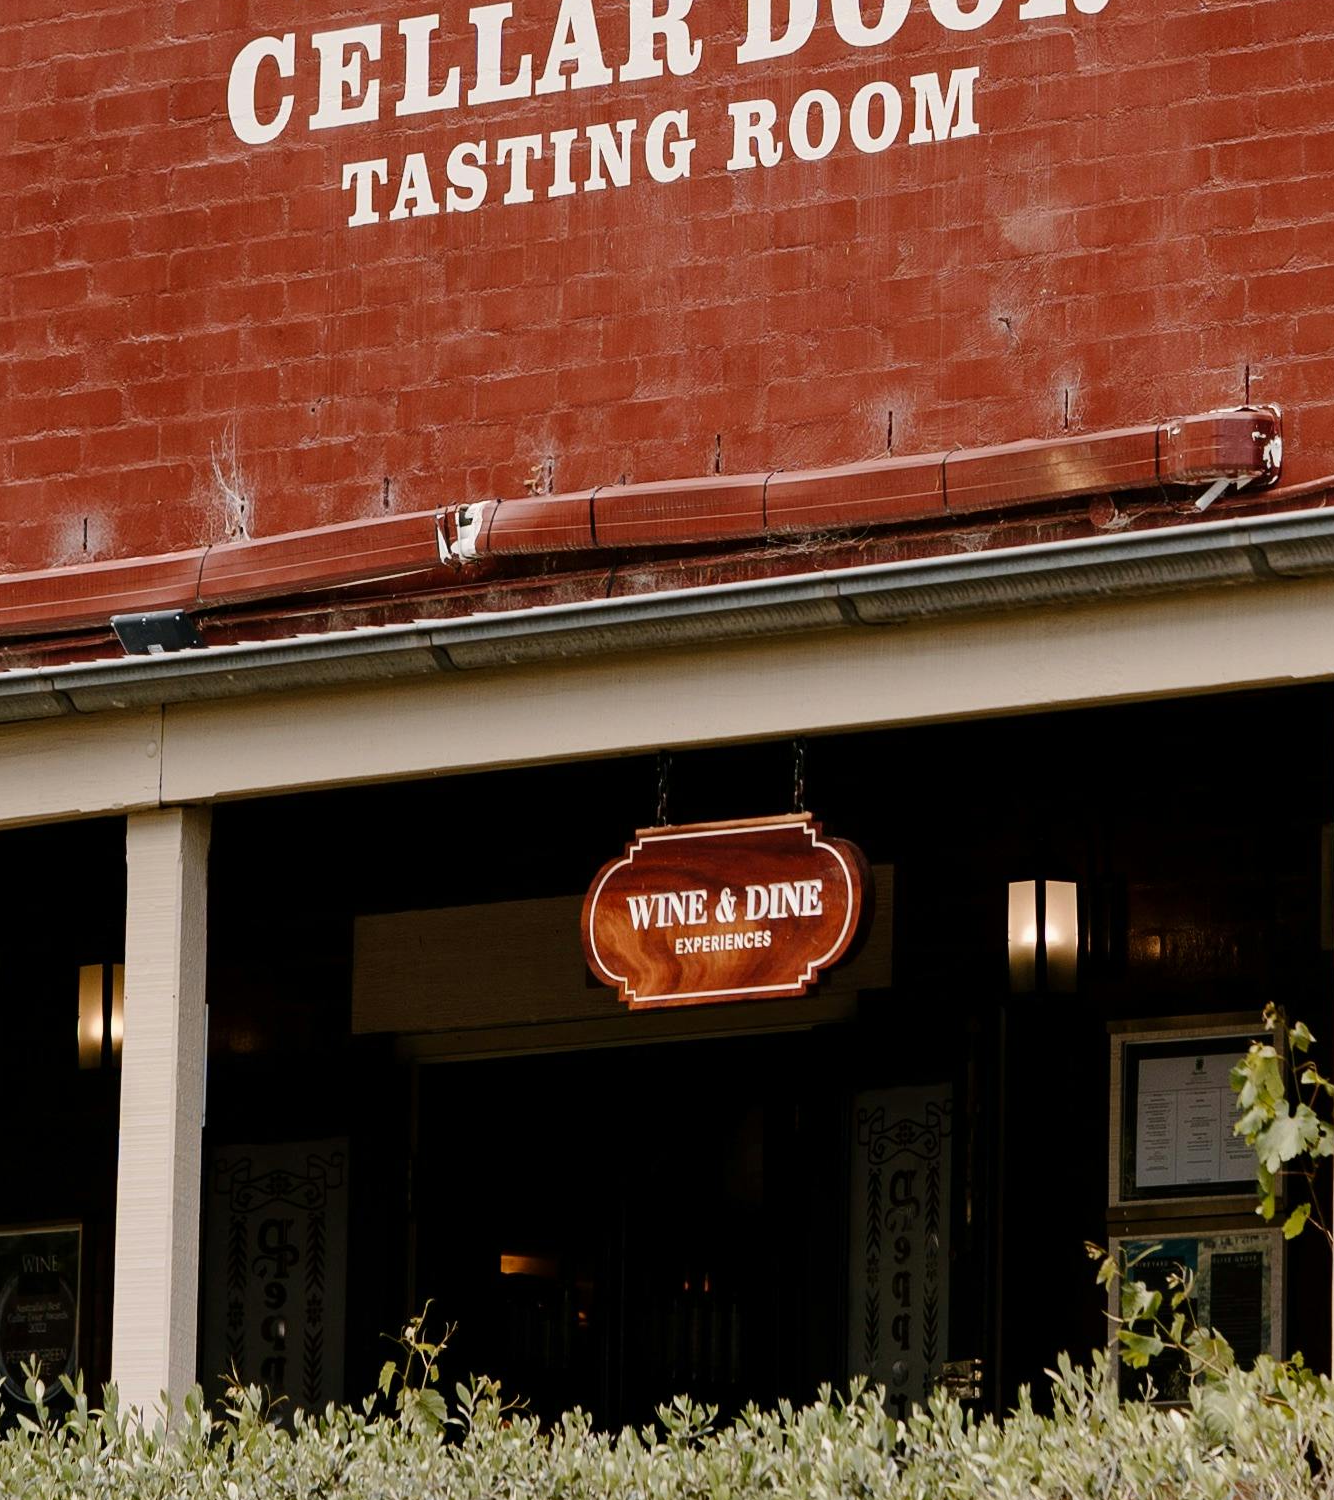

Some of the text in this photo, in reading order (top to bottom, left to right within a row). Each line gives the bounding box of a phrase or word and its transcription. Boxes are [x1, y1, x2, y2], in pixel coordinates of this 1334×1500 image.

[342, 66, 981, 227] TASTING ROOM
[626, 879, 823, 930] WINE & DINE
[675, 929, 772, 954] EXPERIENCES
[21, 1254, 58, 1273] WINE
